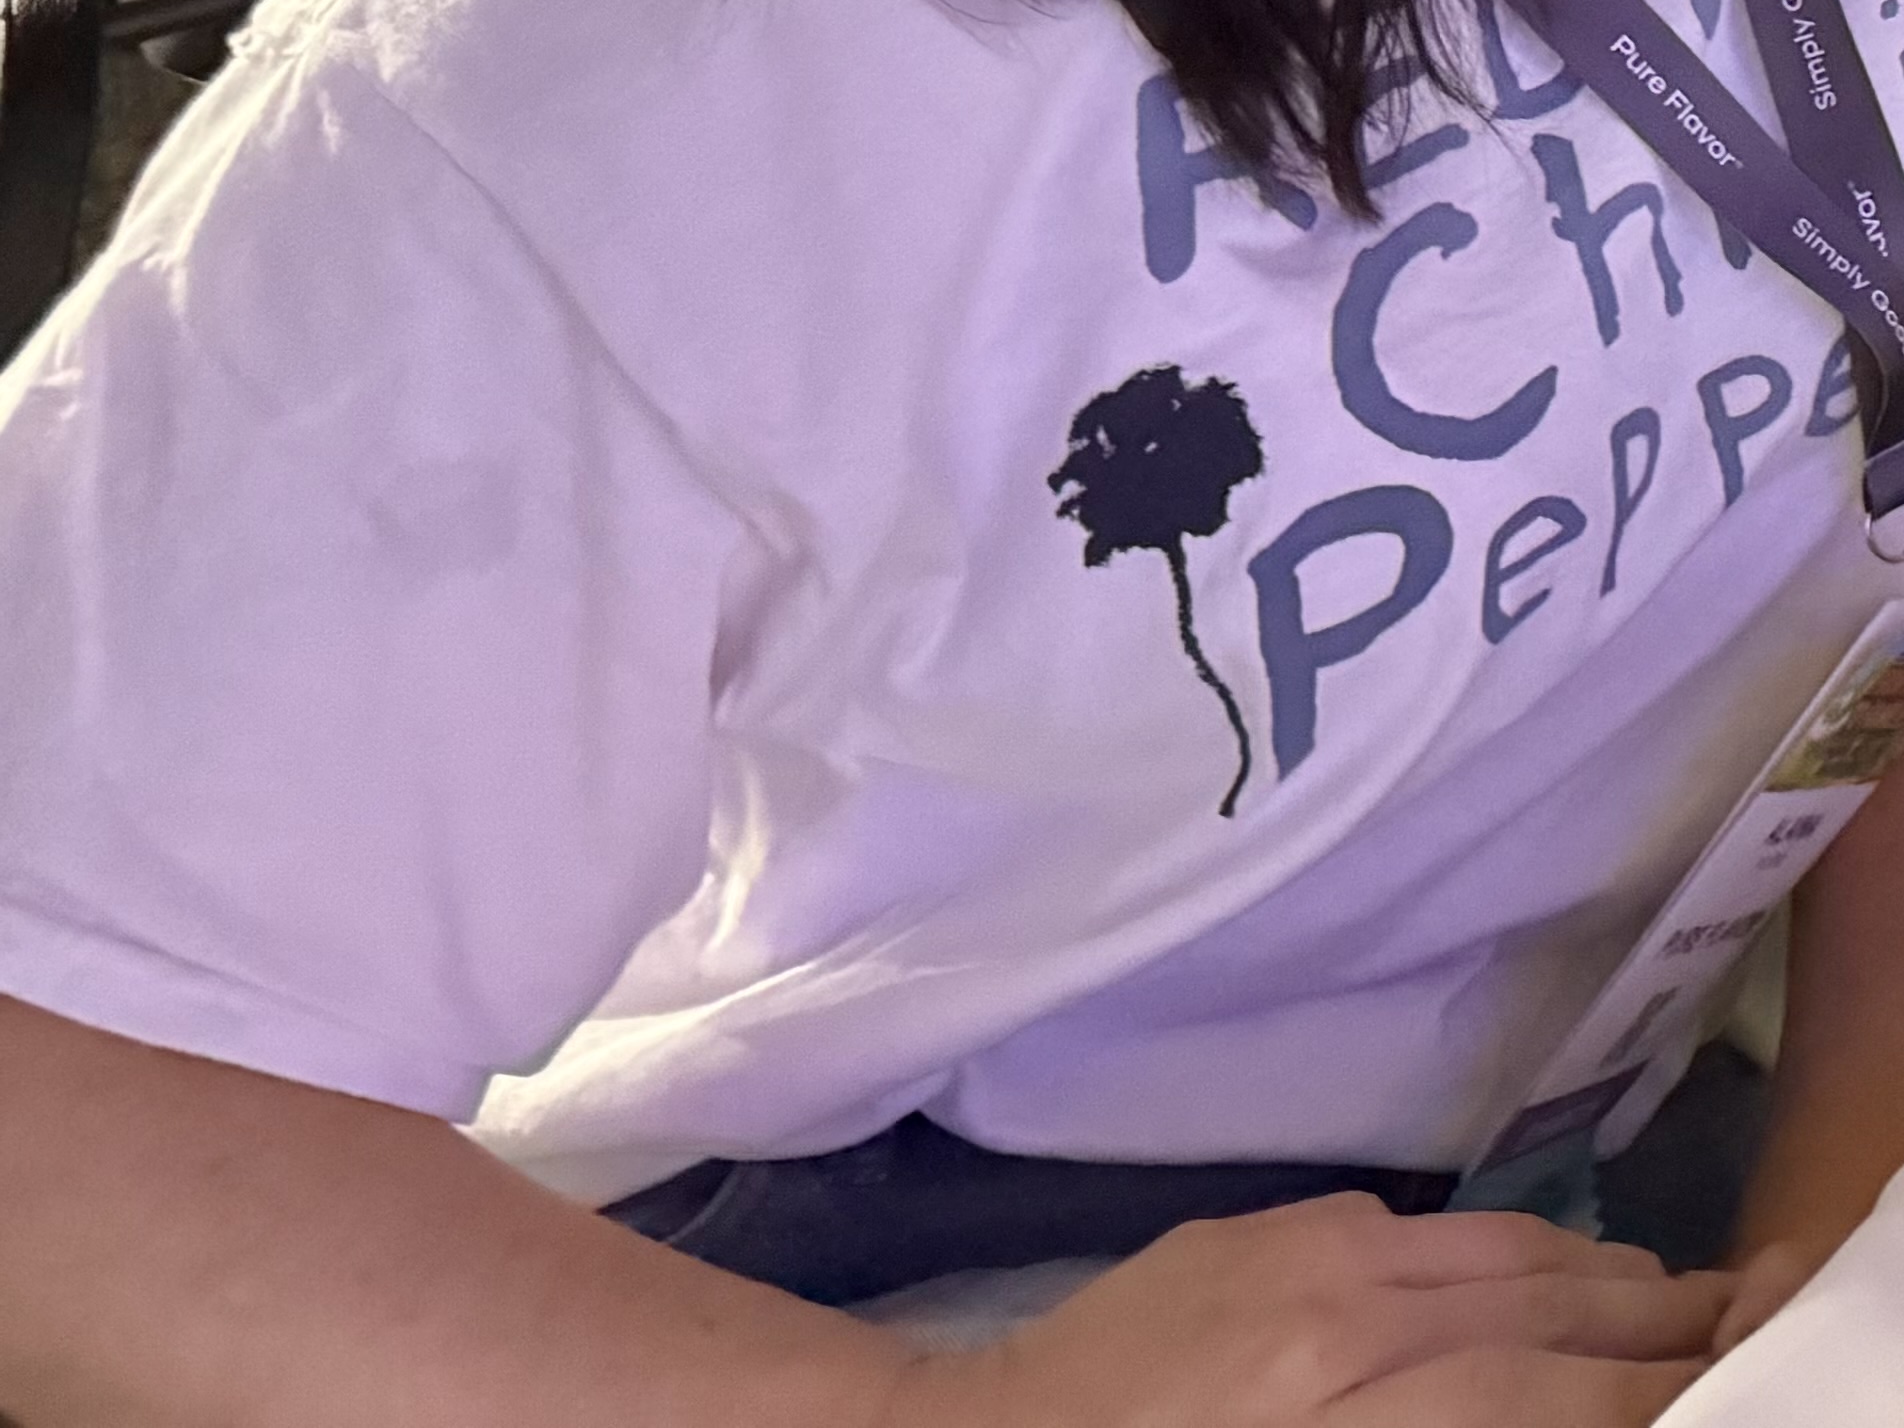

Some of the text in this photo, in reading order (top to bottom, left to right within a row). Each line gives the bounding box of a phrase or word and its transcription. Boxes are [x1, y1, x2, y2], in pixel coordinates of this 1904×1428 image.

[1610, 33, 1668, 96] Pure
[1794, 17, 1837, 111] Simply
[1792, 217, 1871, 290] Simply
